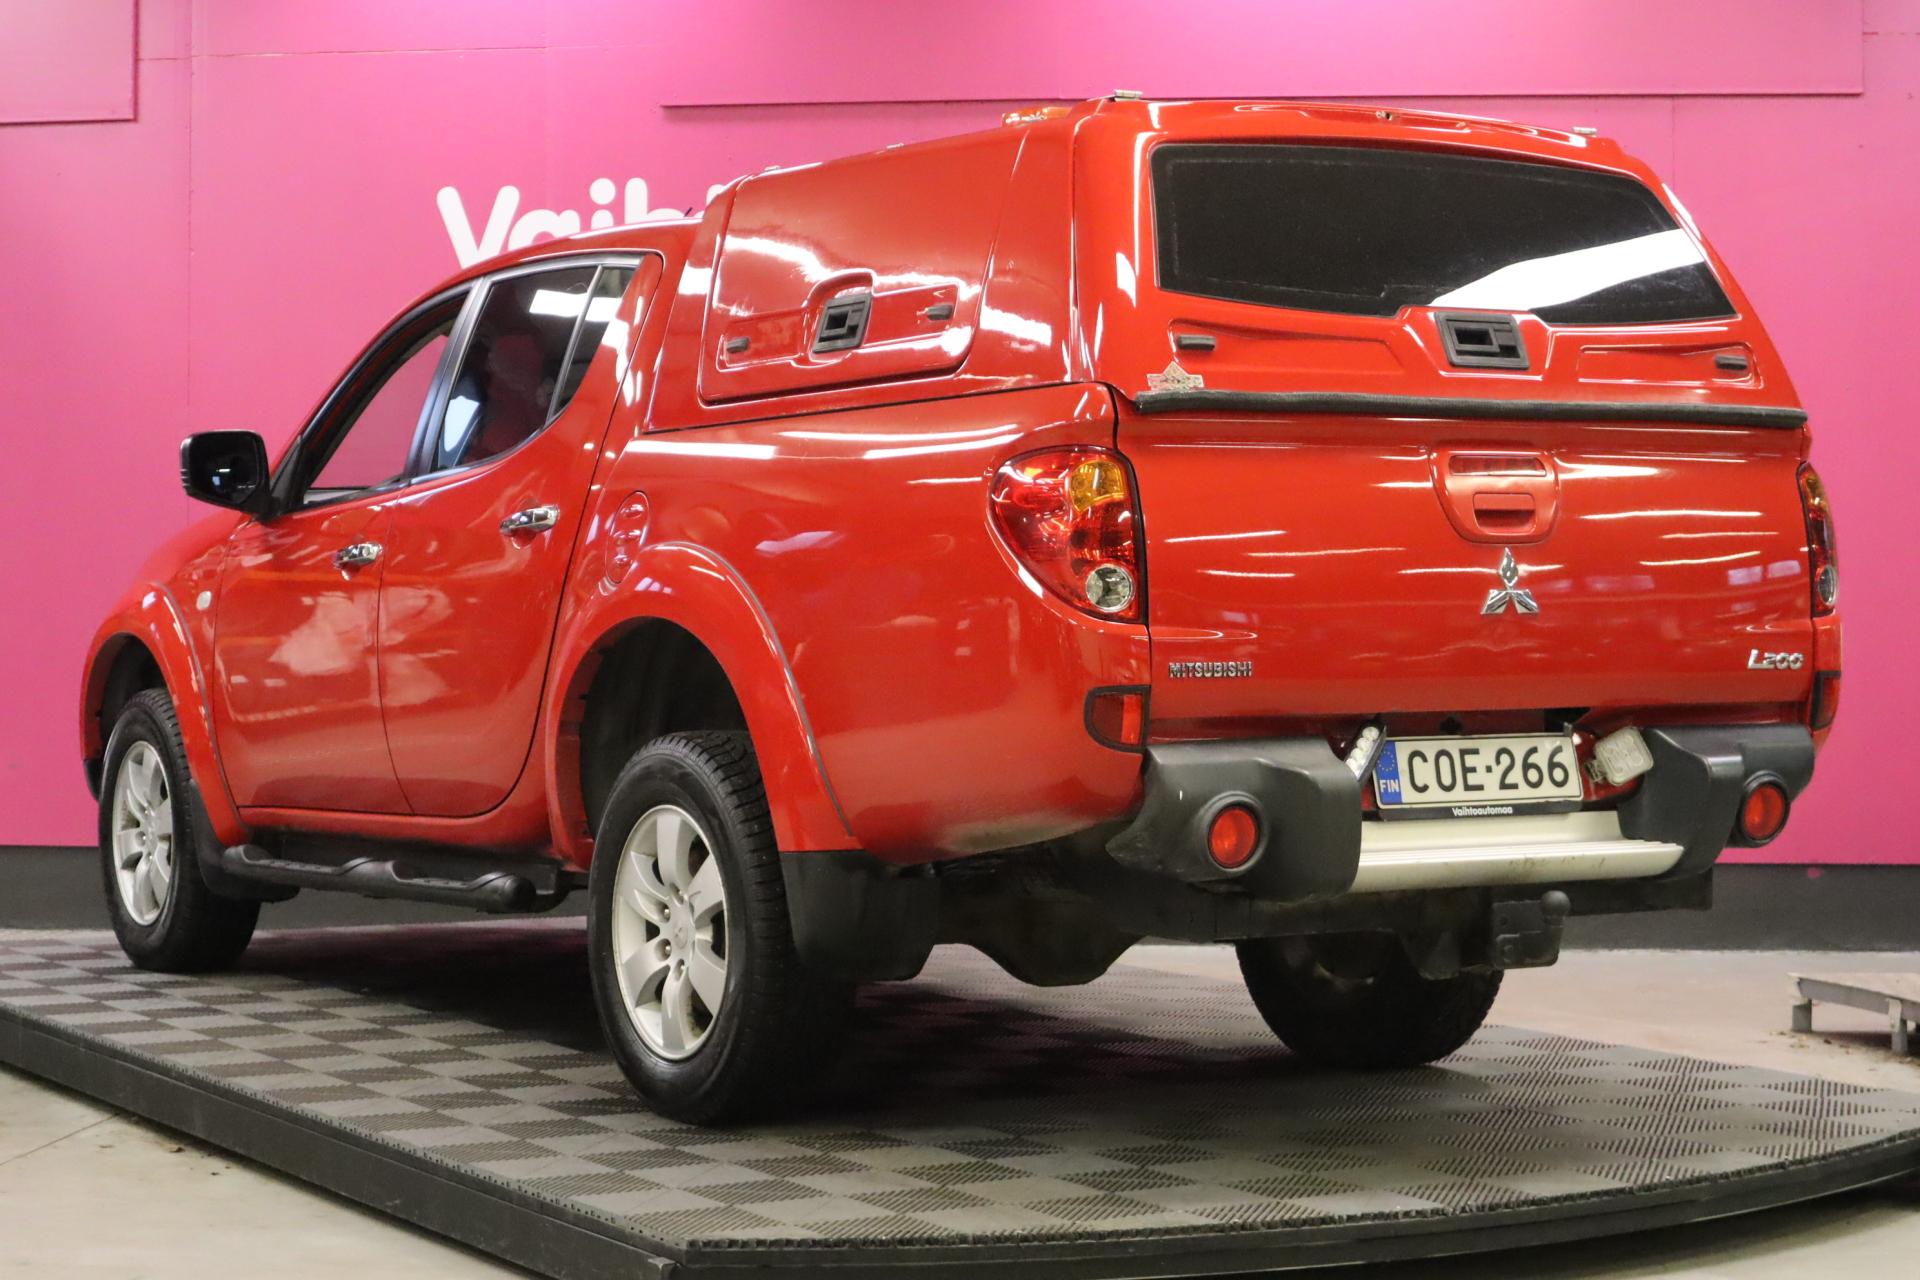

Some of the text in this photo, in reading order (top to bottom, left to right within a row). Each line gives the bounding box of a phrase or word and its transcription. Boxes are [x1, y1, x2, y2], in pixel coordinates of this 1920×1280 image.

[1747, 648, 1804, 669] L200
[1169, 661, 1252, 678] MITSUBISHI
[1407, 745, 1570, 793] COE-266
[1380, 779, 1400, 793] FIN
[1452, 806, 1513, 817] Vaihtoautomaa
